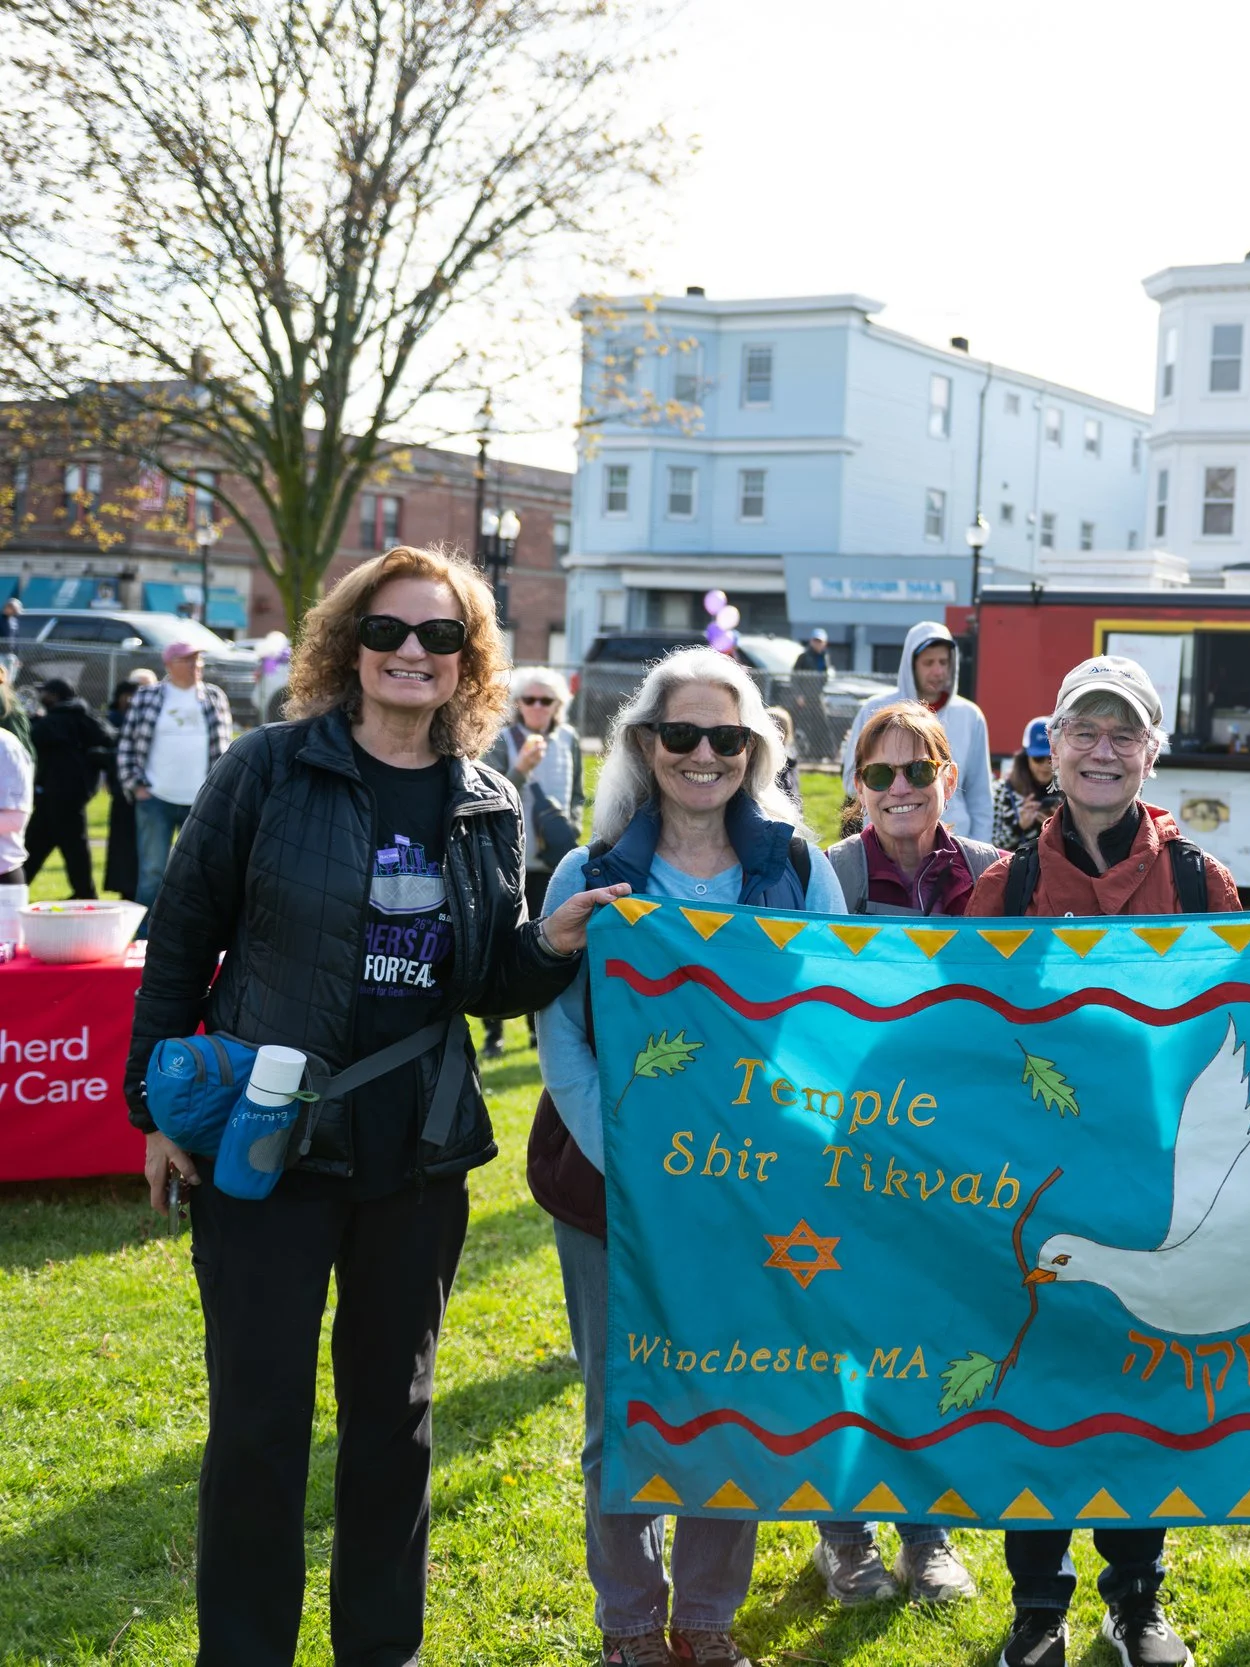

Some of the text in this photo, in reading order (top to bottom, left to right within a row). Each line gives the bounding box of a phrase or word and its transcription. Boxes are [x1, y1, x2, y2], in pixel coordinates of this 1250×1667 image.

[365, 922, 418, 957] HER'S
[0, 1025, 89, 1063] herd
[15, 1070, 108, 1105] Care
[731, 1057, 938, 1135] Temple
[663, 1131, 1021, 1209] Shir Tikvah
[866, 1345, 929, 1379] MA
